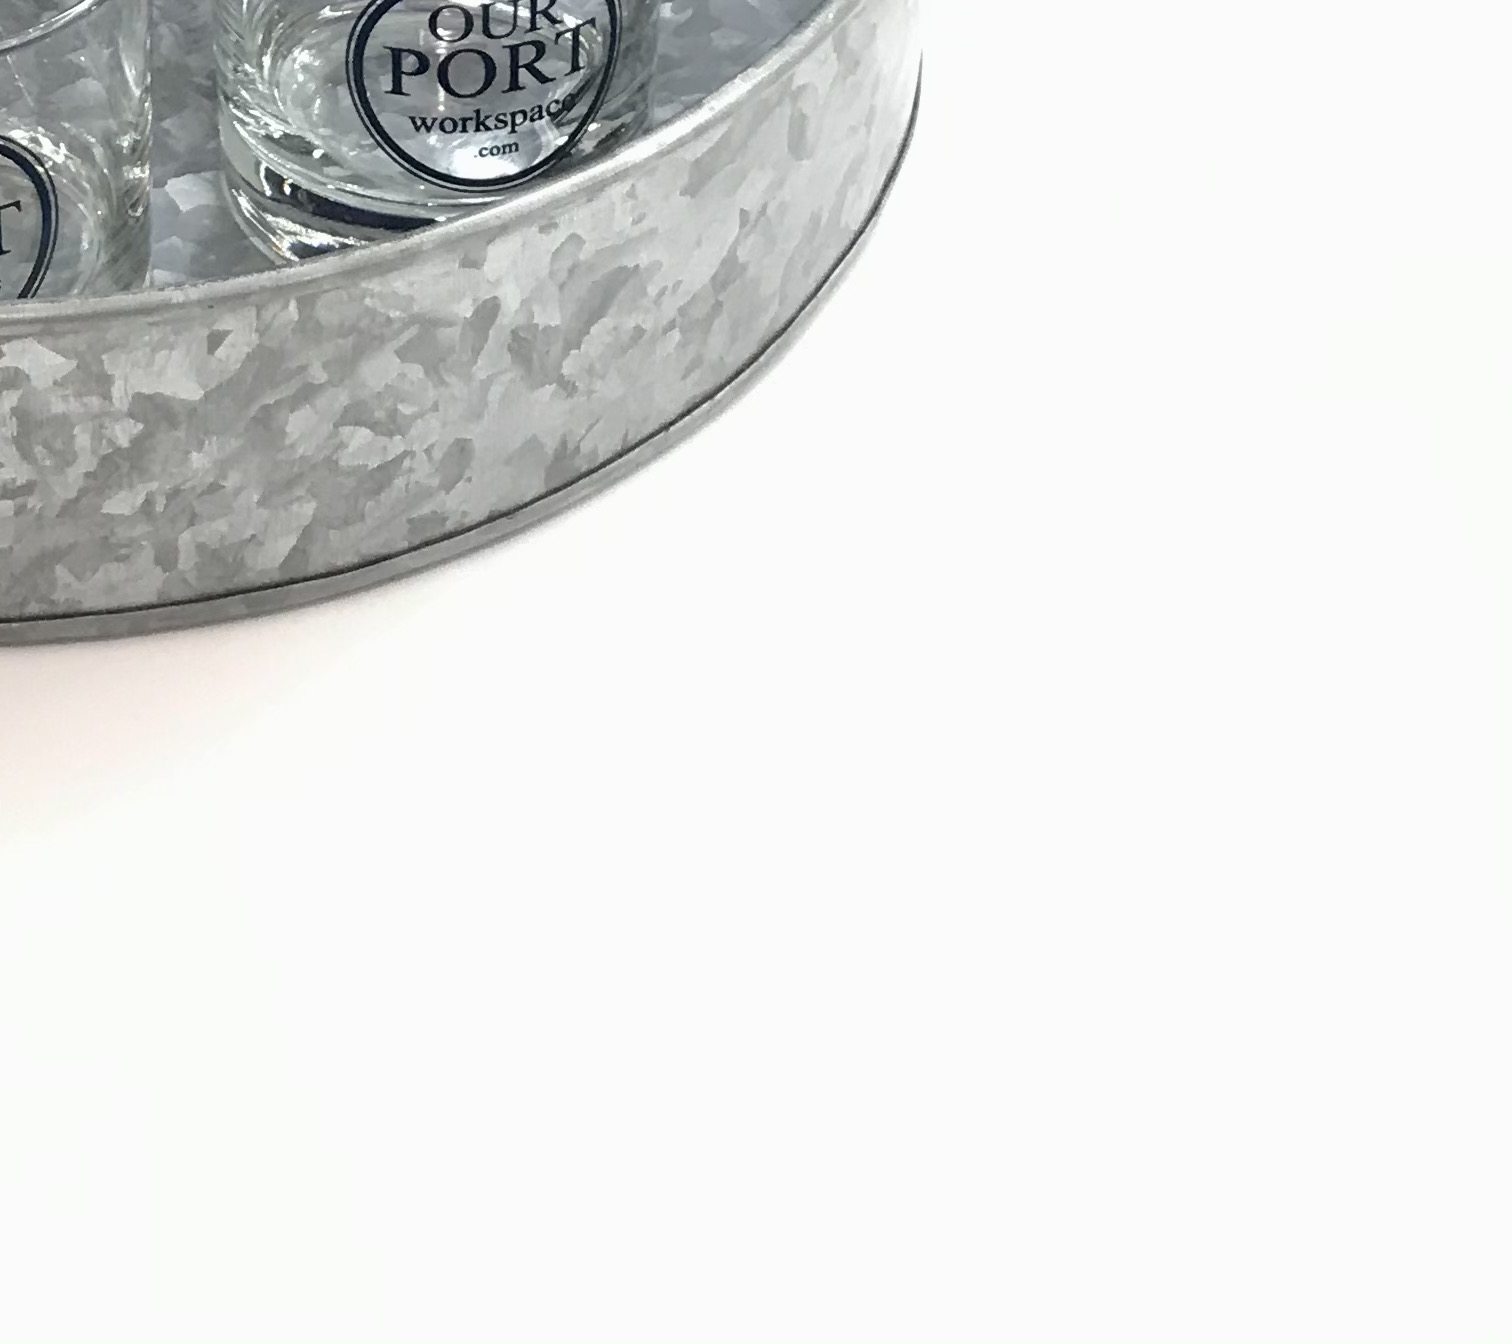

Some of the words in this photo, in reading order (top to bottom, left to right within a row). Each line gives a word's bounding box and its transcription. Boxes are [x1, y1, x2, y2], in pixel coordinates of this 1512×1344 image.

[382, 16, 598, 99] PORT
[408, 91, 580, 135] workspace
[474, 139, 520, 159] .com
